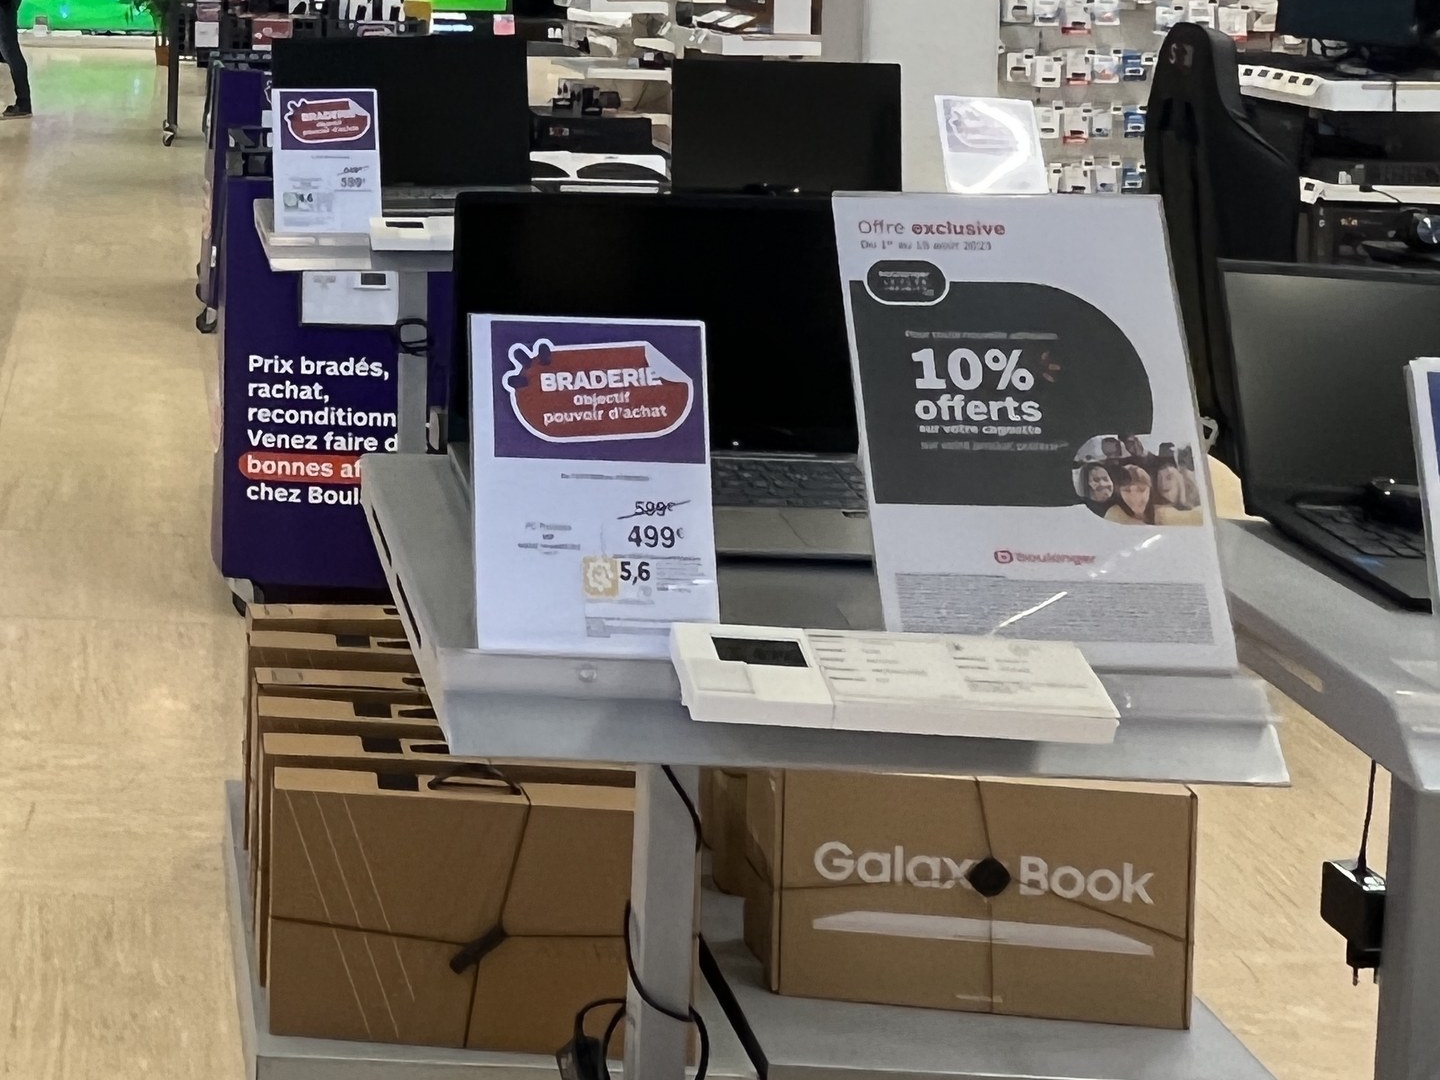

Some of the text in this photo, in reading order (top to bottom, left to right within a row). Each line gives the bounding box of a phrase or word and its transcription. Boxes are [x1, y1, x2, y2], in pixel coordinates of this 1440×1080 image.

[858, 219, 1006, 236] Offre exclusive
[248, 354, 390, 381] Prix bradés,
[540, 367, 663, 392] BRADERIE
[911, 347, 1035, 391] 10%
[247, 380, 330, 403] rachat,
[247, 406, 398, 427] reconditionn
[543, 405, 668, 427] pouvoir d'achat
[914, 394, 1043, 422] offerts
[246, 428, 399, 452] Venez faire d
[246, 454, 361, 478] bonnes af
[246, 482, 360, 506] chez Boul
[627, 524, 685, 549] 499€
[619, 560, 652, 586] 5,6
[813, 840, 1156, 906] Galax Book
